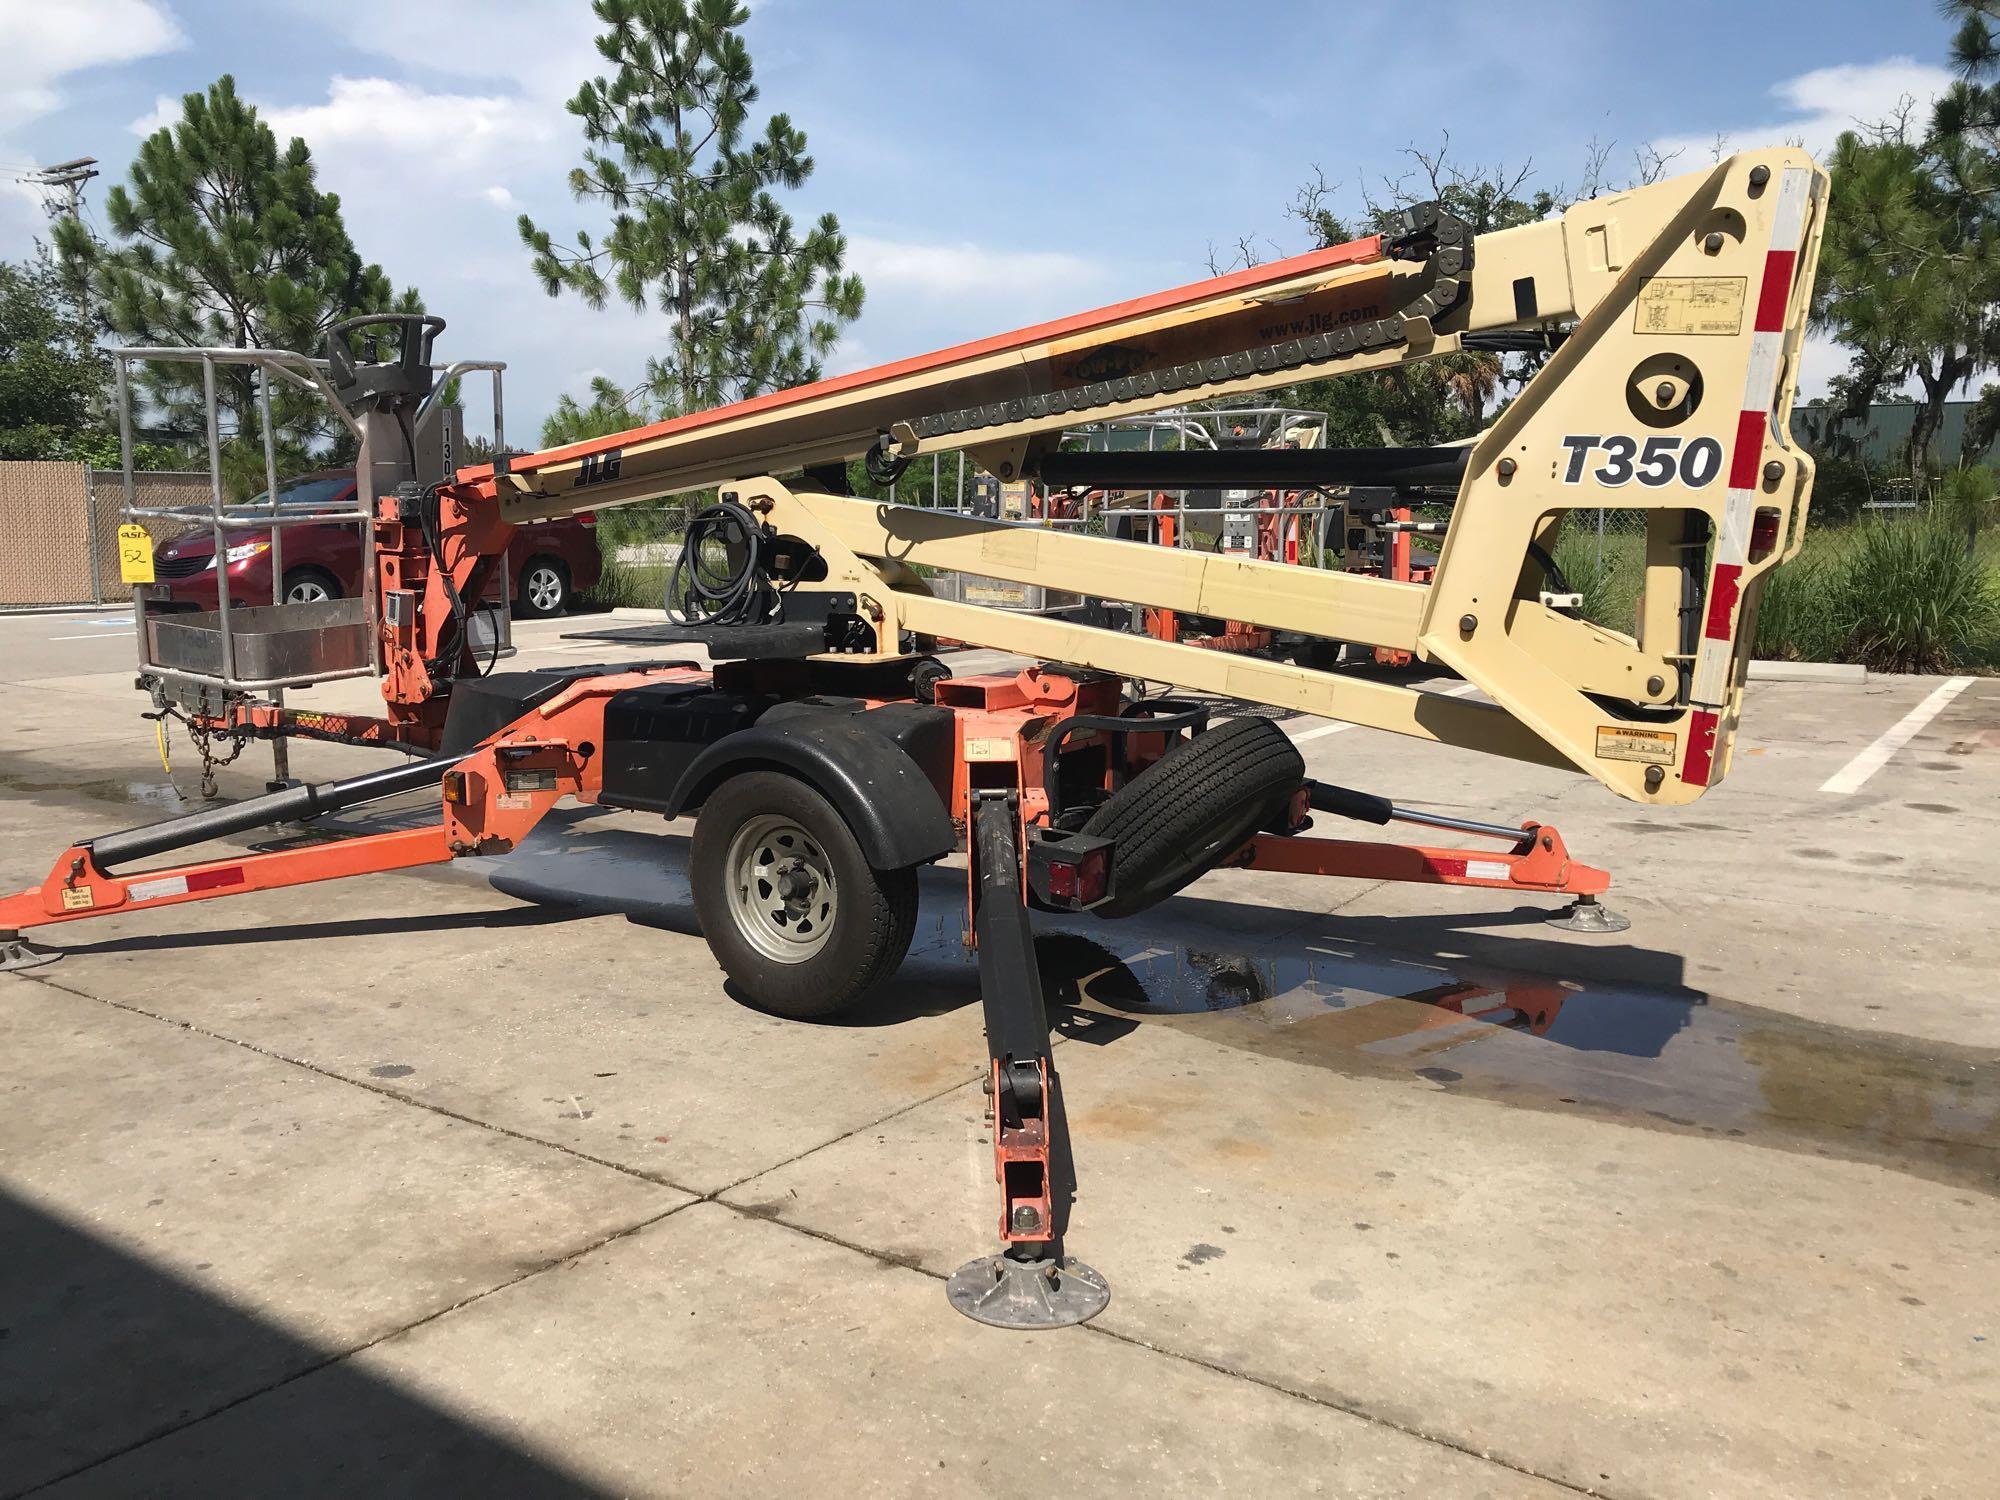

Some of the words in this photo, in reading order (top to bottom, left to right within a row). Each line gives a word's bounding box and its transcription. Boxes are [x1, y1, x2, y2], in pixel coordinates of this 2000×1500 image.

[1259, 304, 1380, 340] www.jlg.com
[574, 450, 622, 487] JLG
[1562, 434, 1723, 489] T350
[125, 549, 147, 563] 52
[1622, 729, 1659, 739] WARNING
